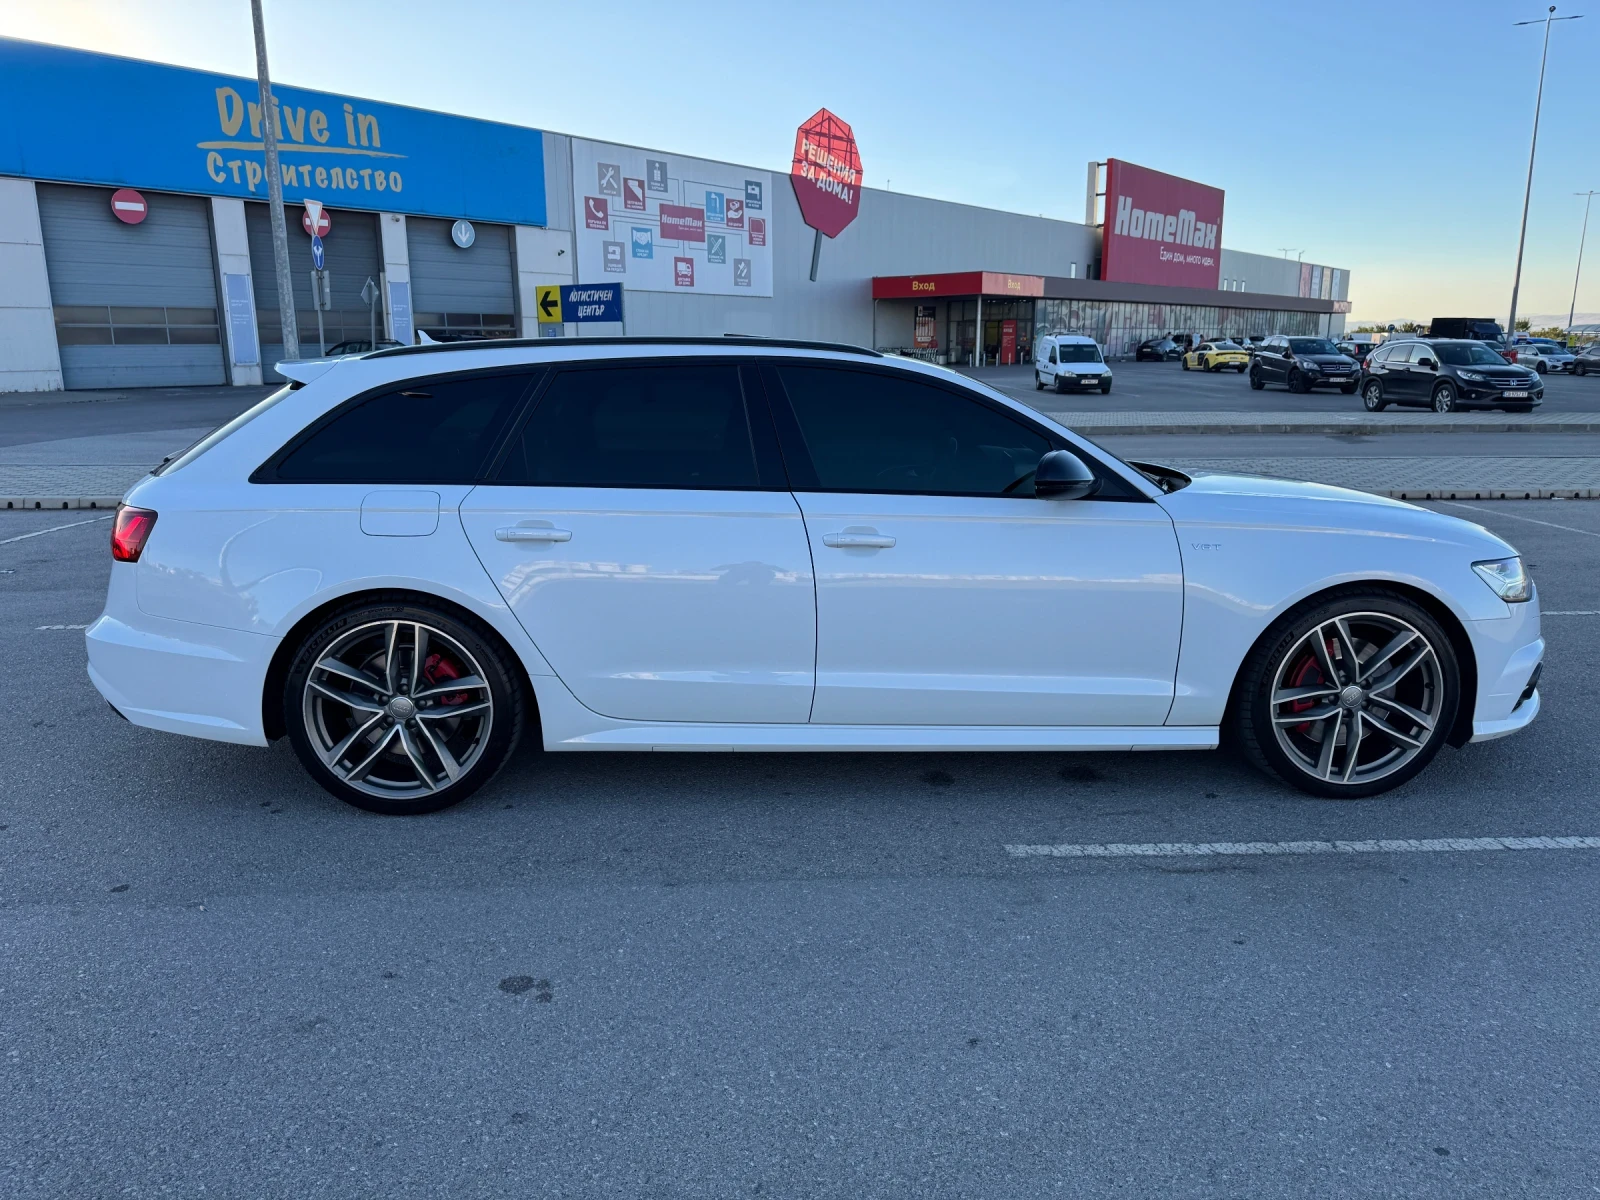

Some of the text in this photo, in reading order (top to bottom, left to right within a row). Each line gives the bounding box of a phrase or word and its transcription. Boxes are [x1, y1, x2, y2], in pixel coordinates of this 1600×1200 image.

[215, 86, 381, 148] Drive in
[801, 138, 856, 185] РЕШЕНИЯ
[800, 160, 854, 205] ЗА ДОМА!
[661, 213, 703, 228] HomeMax
[1114, 195, 1217, 250] HomeMax
[1160, 246, 1173, 262] Един
[1173, 252, 1185, 265] дом,
[1186, 255, 1201, 265] много
[568, 289, 613, 303] ЛОГИСТИЧЕН
[912, 281, 935, 291] Вход
[1007, 279, 1021, 290] Вход
[577, 304, 605, 319] ЦЕНТЪР
[303, 619, 344, 662] MICHELIN
[1262, 633, 1293, 684] MICHELIN
